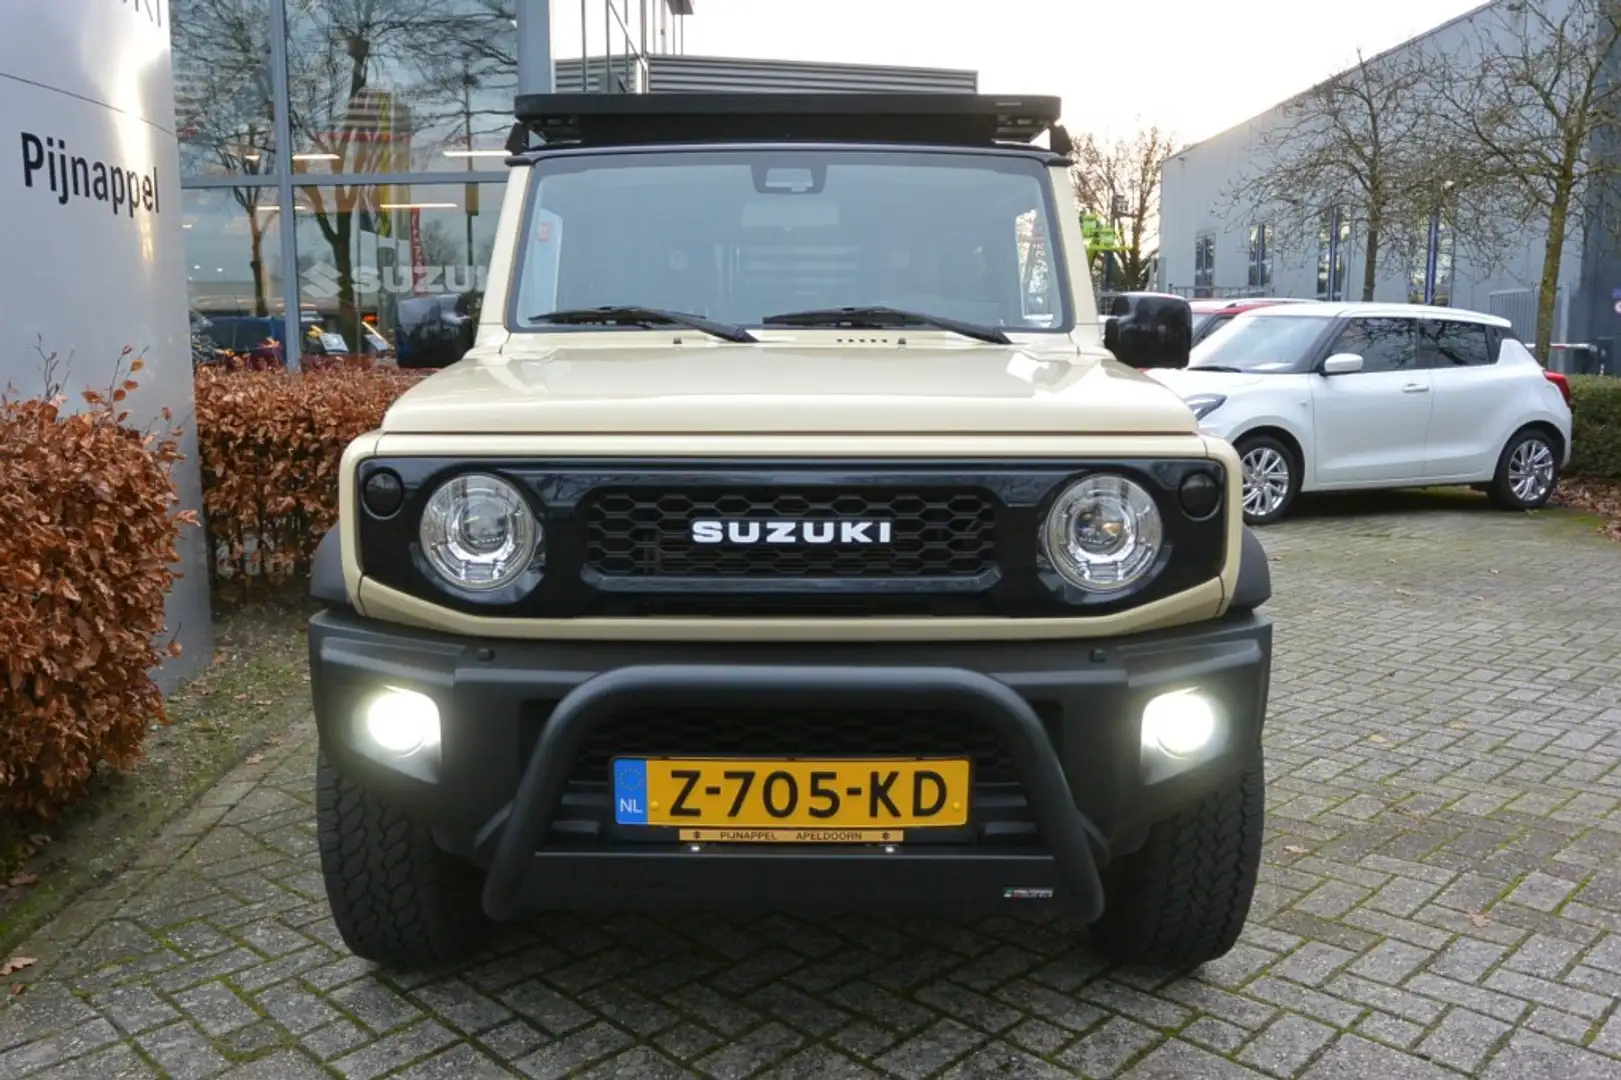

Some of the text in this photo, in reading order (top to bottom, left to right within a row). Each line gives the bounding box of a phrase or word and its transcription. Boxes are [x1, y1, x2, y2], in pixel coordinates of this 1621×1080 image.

[21, 131, 160, 218] Pijnappel
[692, 521, 891, 543] SUZUKI
[669, 770, 948, 818] Z-705-KD
[619, 798, 643, 814] NL
[720, 831, 863, 840] PIJNAPPEL APELDOORN
